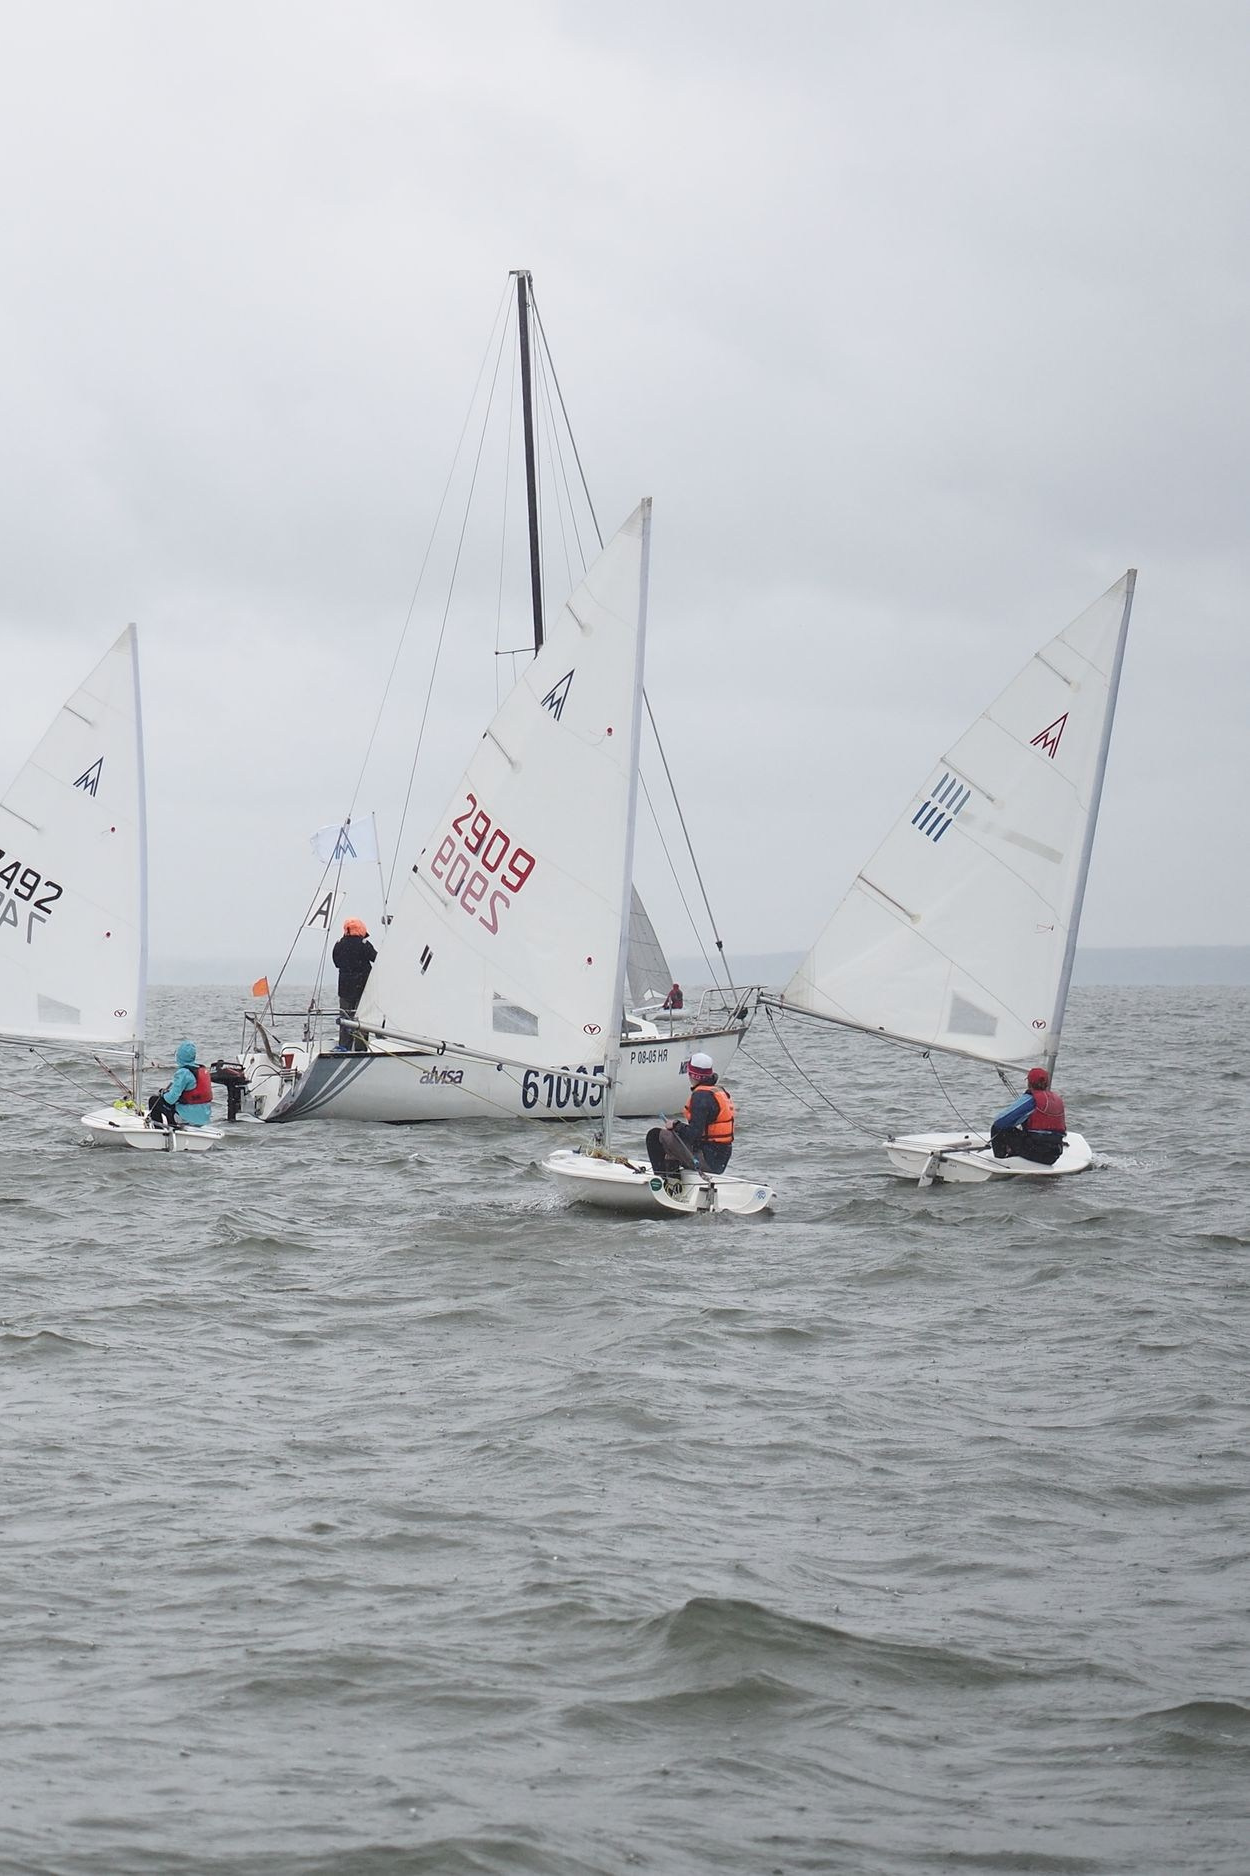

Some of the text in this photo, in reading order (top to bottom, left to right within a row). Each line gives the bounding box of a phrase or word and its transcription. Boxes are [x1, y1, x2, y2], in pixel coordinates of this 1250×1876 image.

[452, 793, 536, 893] 2909
[308, 892, 332, 928] A
[522, 1065, 604, 1109] 61005
